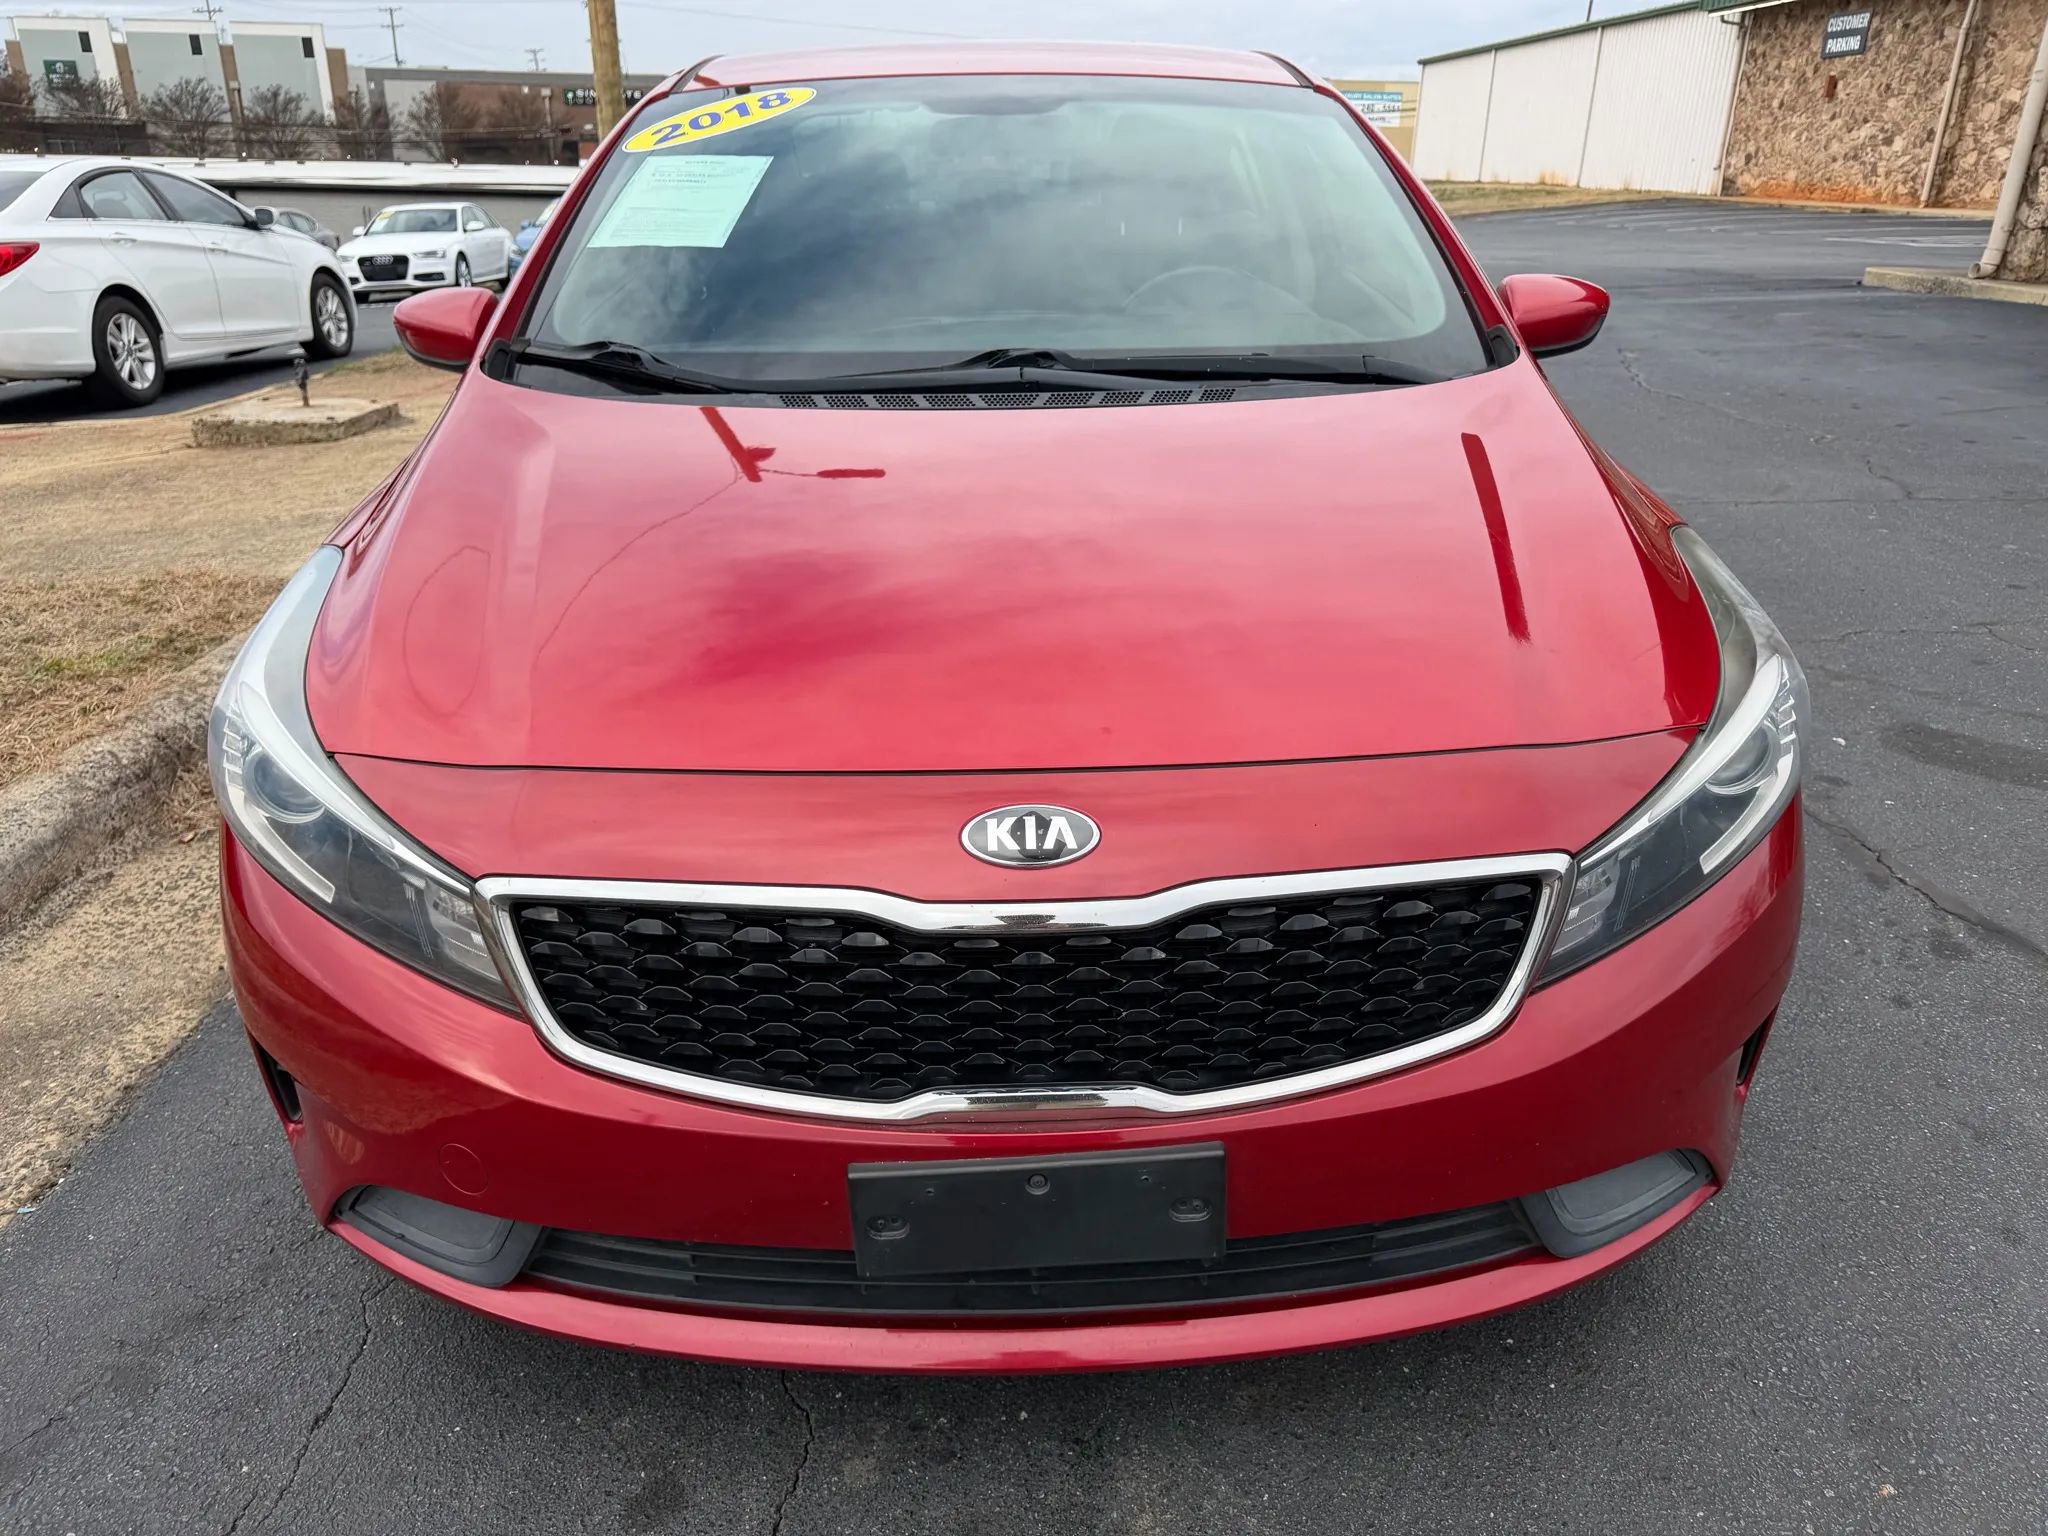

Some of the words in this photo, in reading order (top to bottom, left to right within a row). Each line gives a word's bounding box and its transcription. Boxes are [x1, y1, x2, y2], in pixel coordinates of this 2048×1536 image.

[1828, 13, 1870, 32] CUSTOMER
[1826, 35, 1860, 53] PARKING
[651, 91, 793, 147] 2018
[985, 815, 1079, 852] KIA
